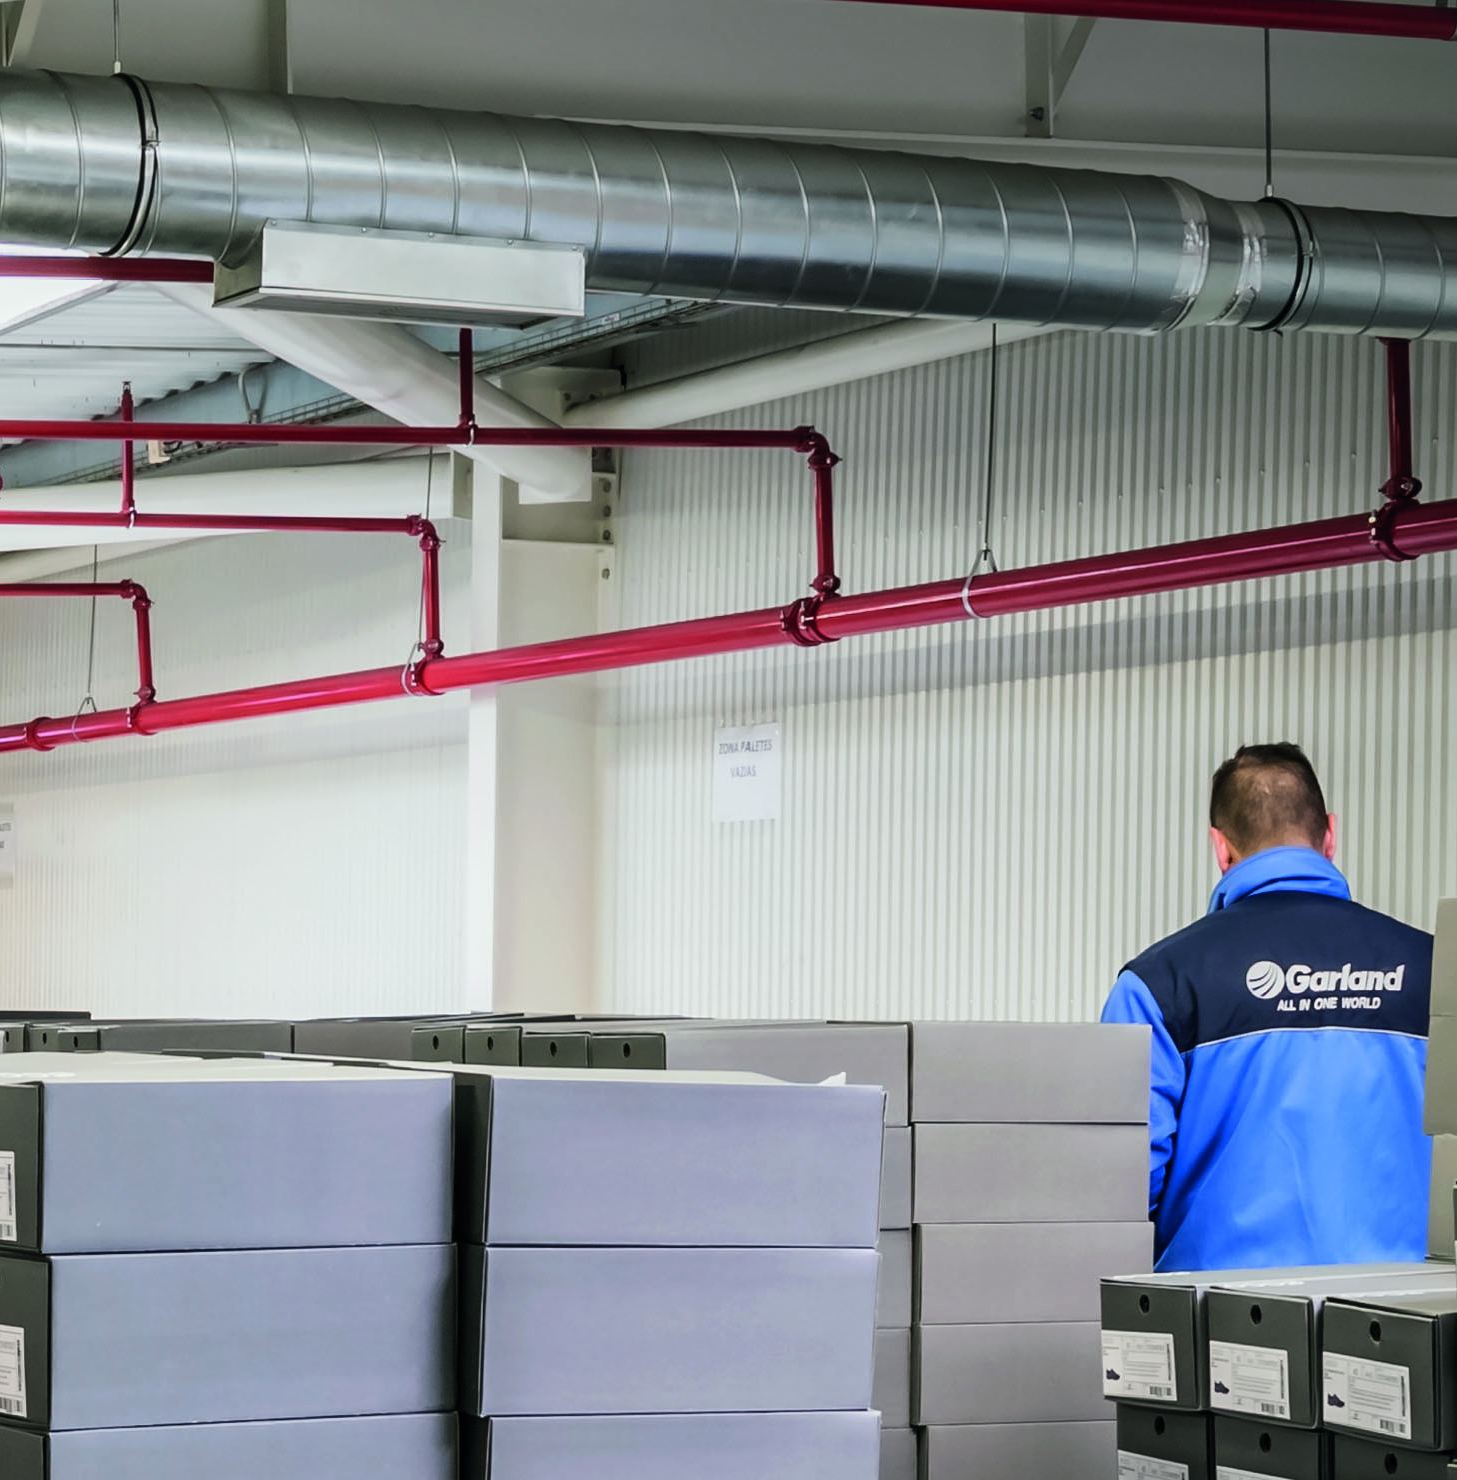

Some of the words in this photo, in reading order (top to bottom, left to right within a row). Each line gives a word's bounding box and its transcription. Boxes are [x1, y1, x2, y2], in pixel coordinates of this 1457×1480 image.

[719, 742, 739, 755] ZONA
[1286, 963, 1406, 994] Garland
[1277, 999, 1297, 1012] ALL
[1299, 998, 1310, 1011] IN
[1314, 997, 1338, 1011] ONE
[1341, 996, 1382, 1010] WORLD
